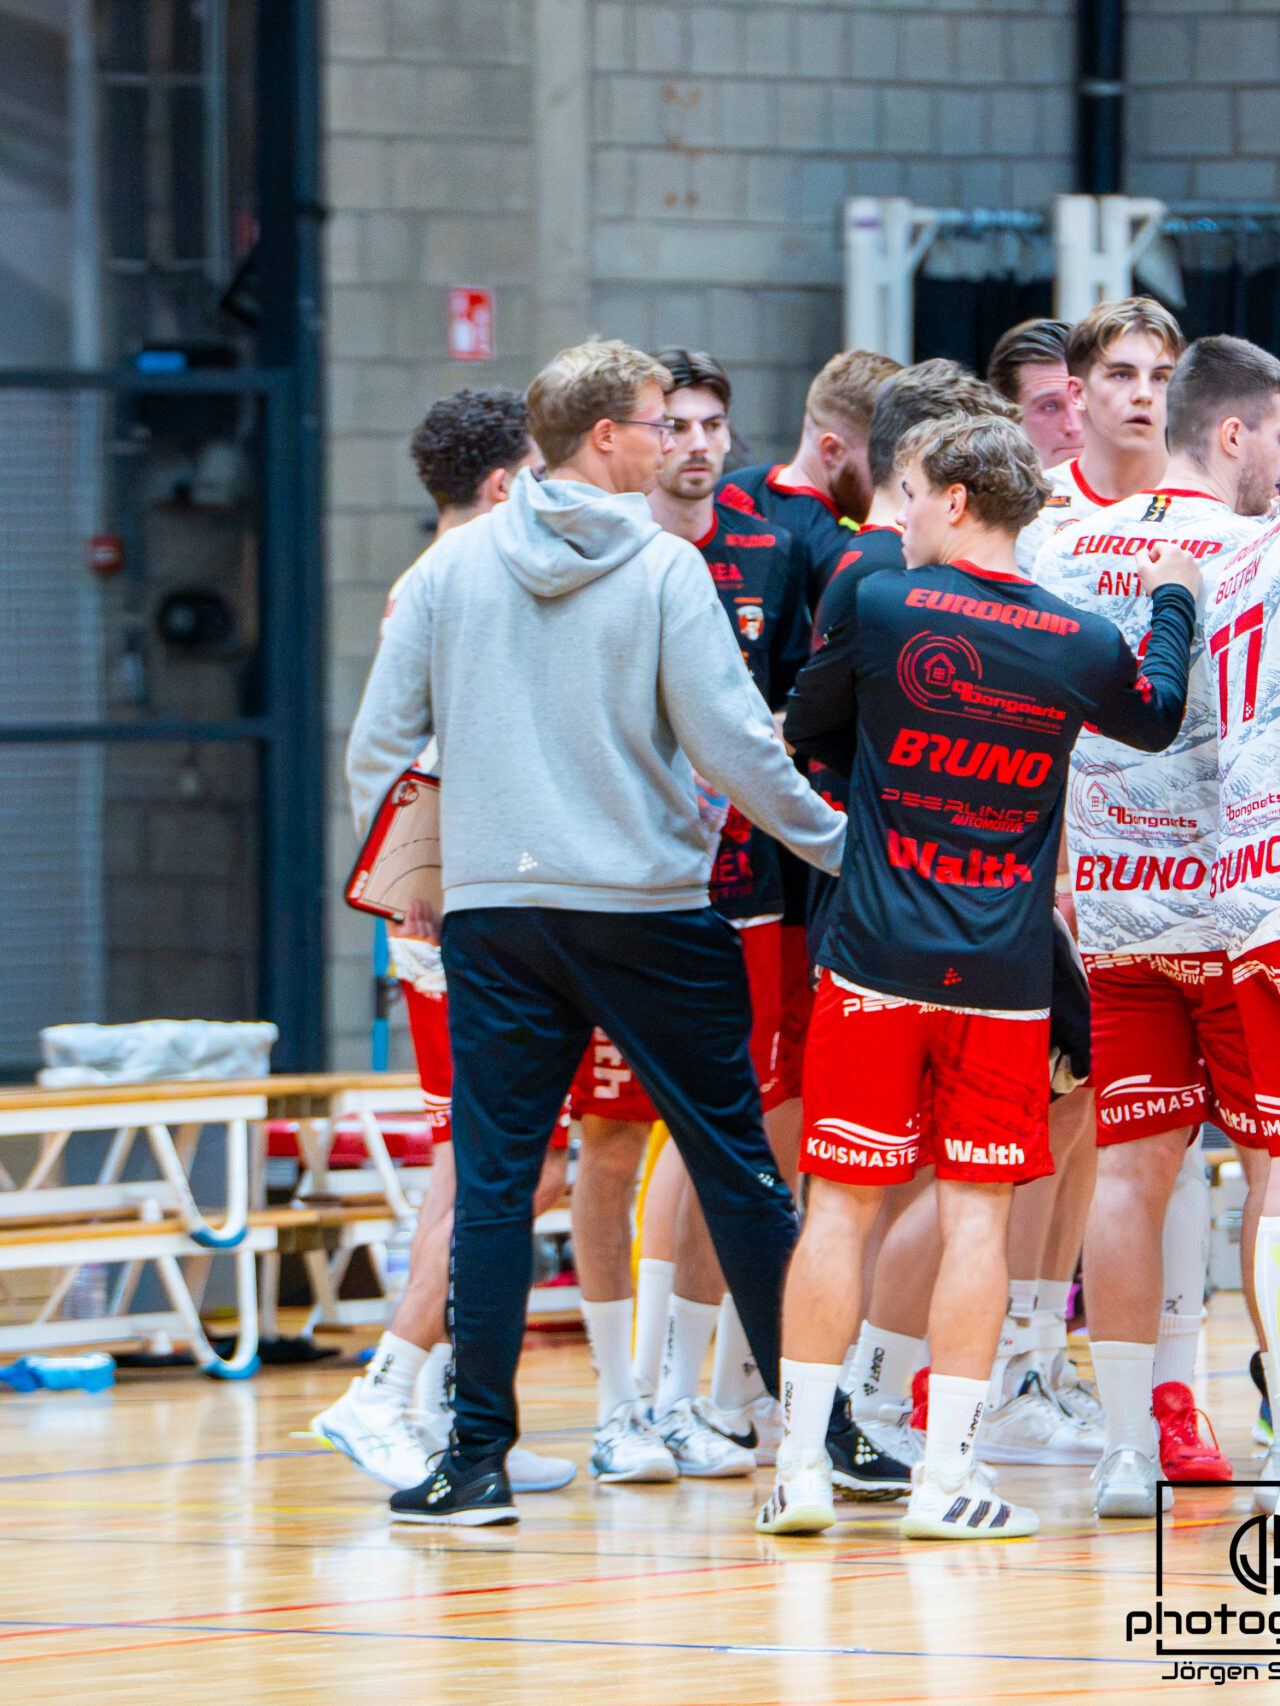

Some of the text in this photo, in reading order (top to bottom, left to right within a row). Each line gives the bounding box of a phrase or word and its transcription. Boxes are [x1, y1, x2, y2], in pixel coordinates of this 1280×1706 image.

[1072, 534, 1224, 560] EUROIP
[1098, 570, 1152, 598] ANT
[904, 586, 1081, 636] EUROQUIP
[888, 728, 1053, 788] BRUNO
[951, 814, 1025, 833] AUTOMOTIVE
[888, 829, 1033, 889] Walth
[1075, 855, 1208, 892] BRUNO
[944, 1138, 1026, 1166] Walth
